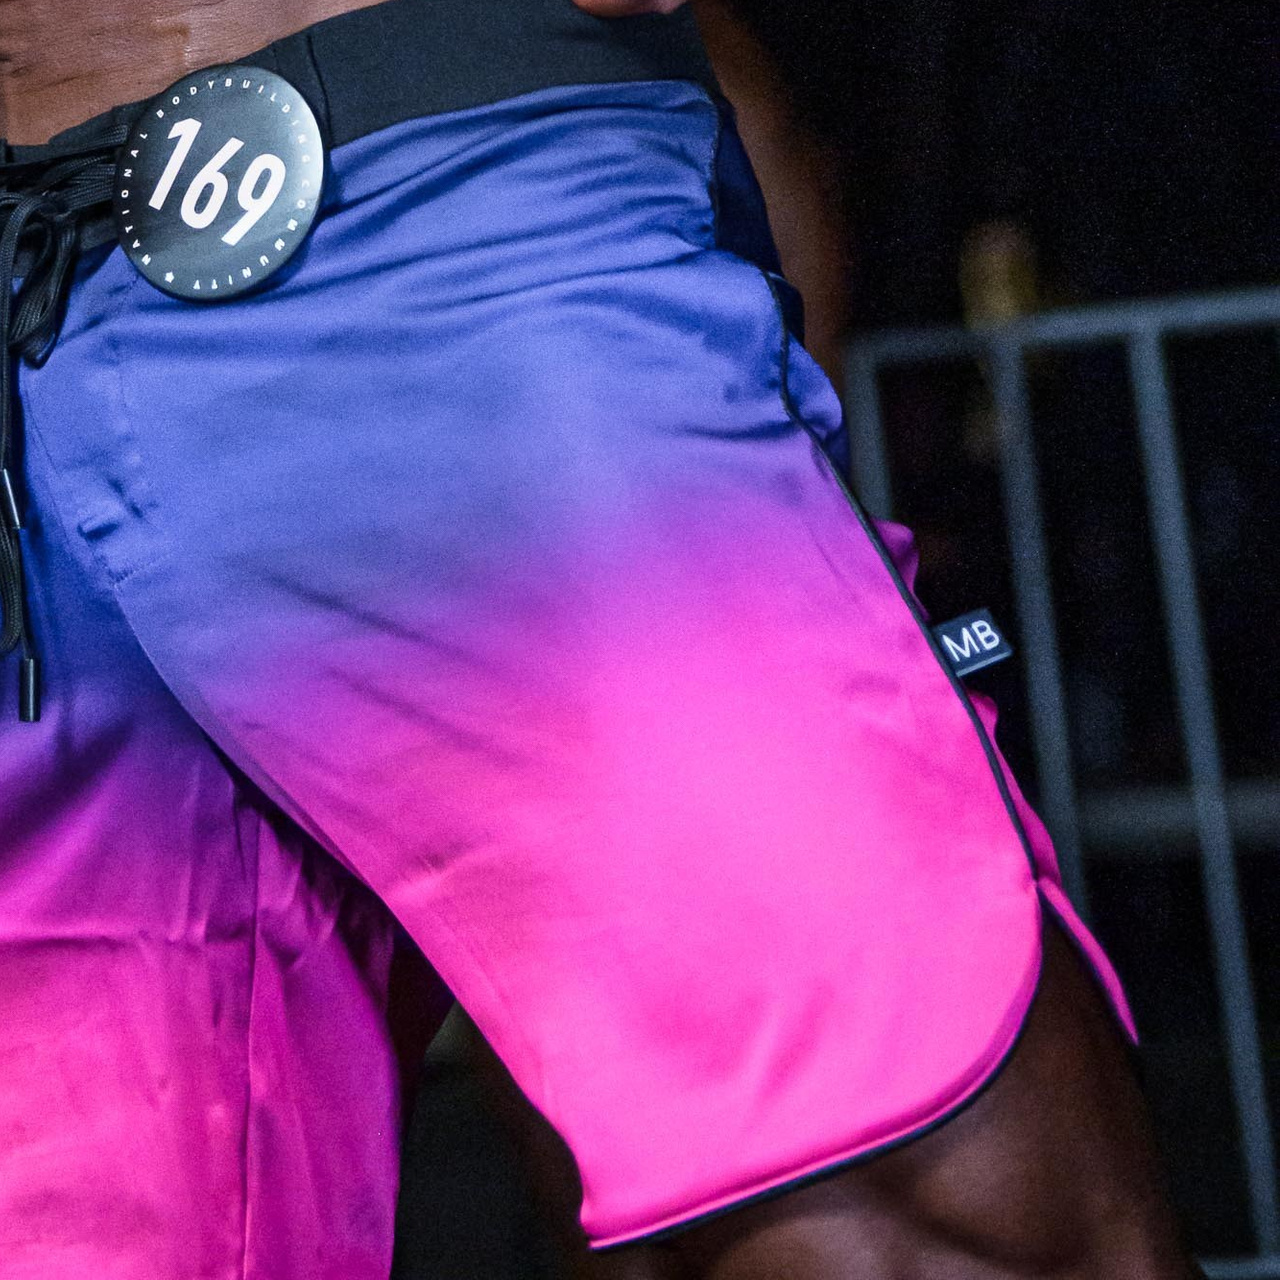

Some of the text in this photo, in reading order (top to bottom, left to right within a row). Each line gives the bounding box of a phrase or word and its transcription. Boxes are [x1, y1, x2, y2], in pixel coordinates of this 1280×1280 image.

[120, 77, 311, 290] NATIONAL BODYBUILDING COMMUNITY
[148, 117, 287, 247] 169
[942, 620, 1000, 662] MB
